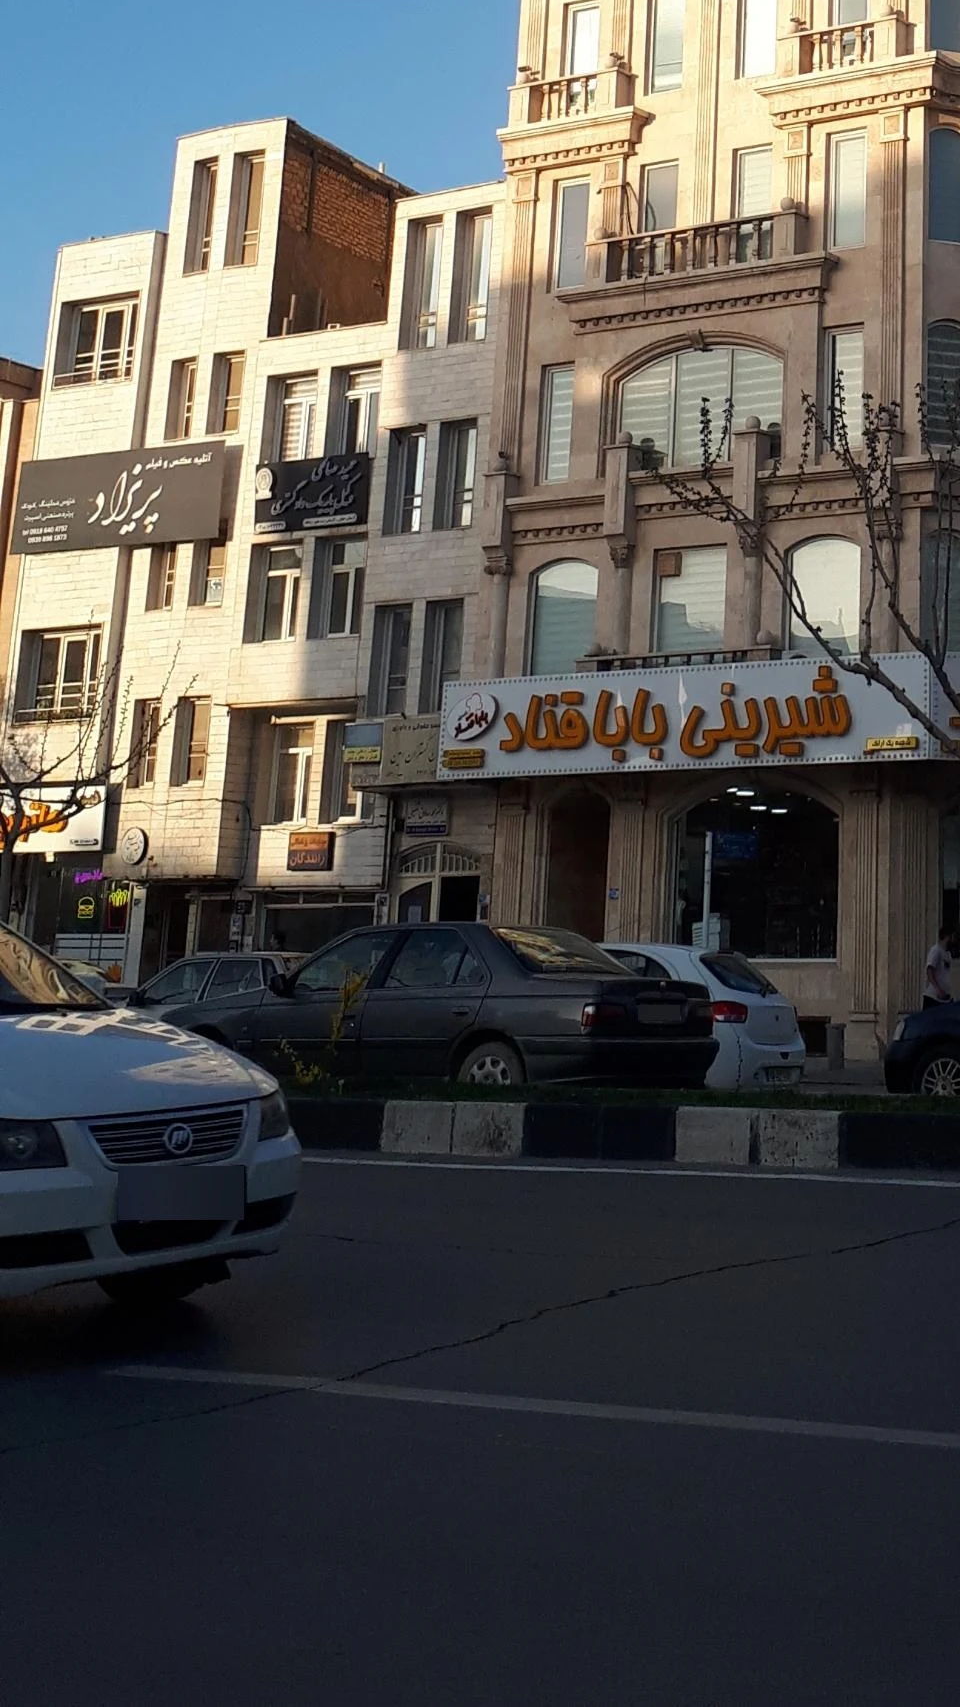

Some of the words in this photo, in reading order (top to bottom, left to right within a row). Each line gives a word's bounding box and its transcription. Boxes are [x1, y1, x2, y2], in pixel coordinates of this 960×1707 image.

[145, 456, 162, 470] فیلم
[163, 460, 168, 469] و
[169, 456, 192, 469] عکس
[193, 452, 213, 466] آتلیه
[680, 665, 852, 759] شیرینی
[289, 852, 326, 867] رانندگان
